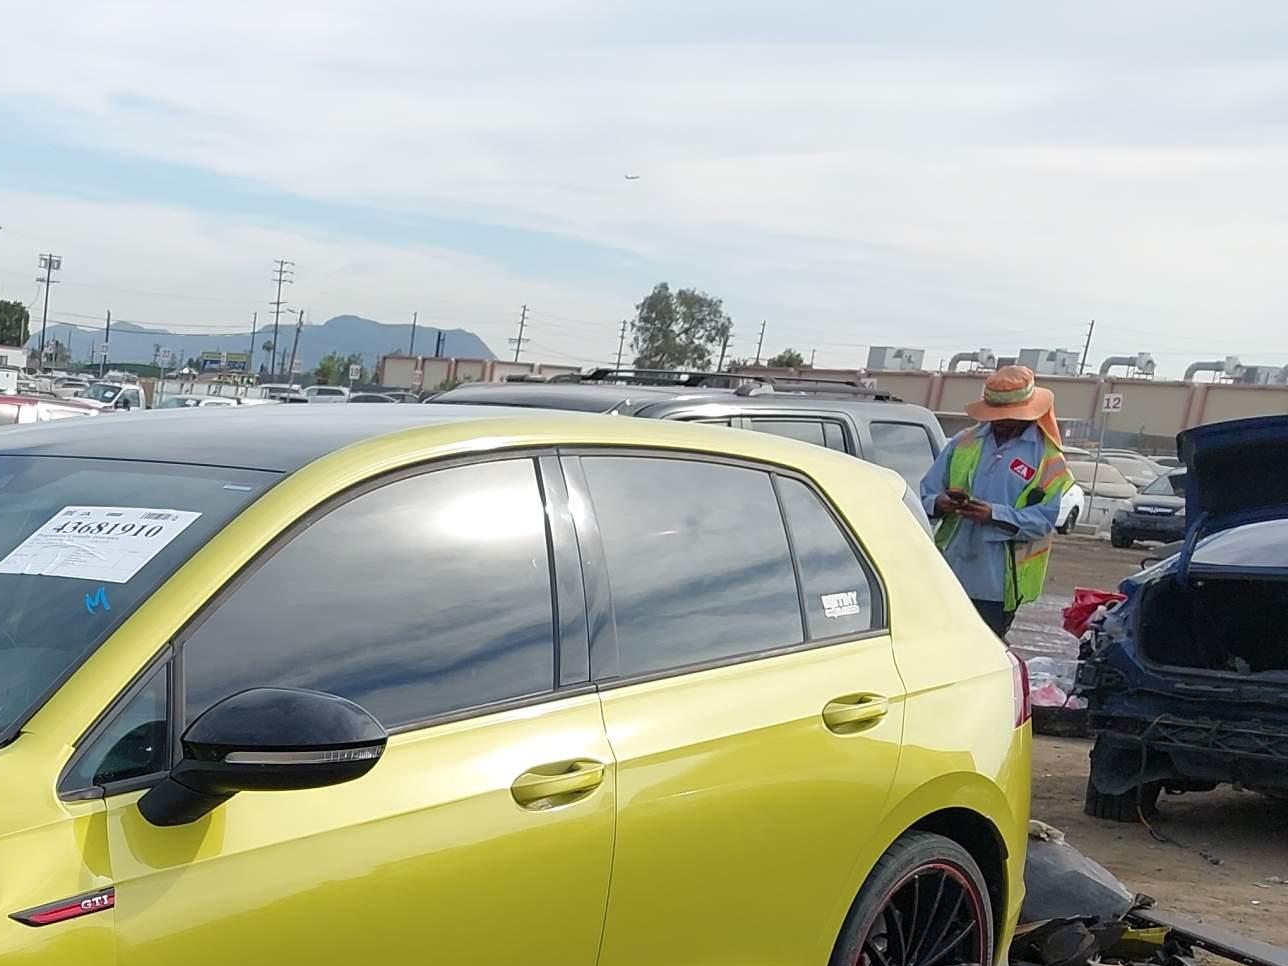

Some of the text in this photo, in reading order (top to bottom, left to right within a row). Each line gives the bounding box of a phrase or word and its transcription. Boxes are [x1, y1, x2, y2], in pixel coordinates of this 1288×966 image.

[1103, 397, 1121, 409] 12
[51, 520, 165, 539] 43681910
[81, 894, 109, 910] GTI
